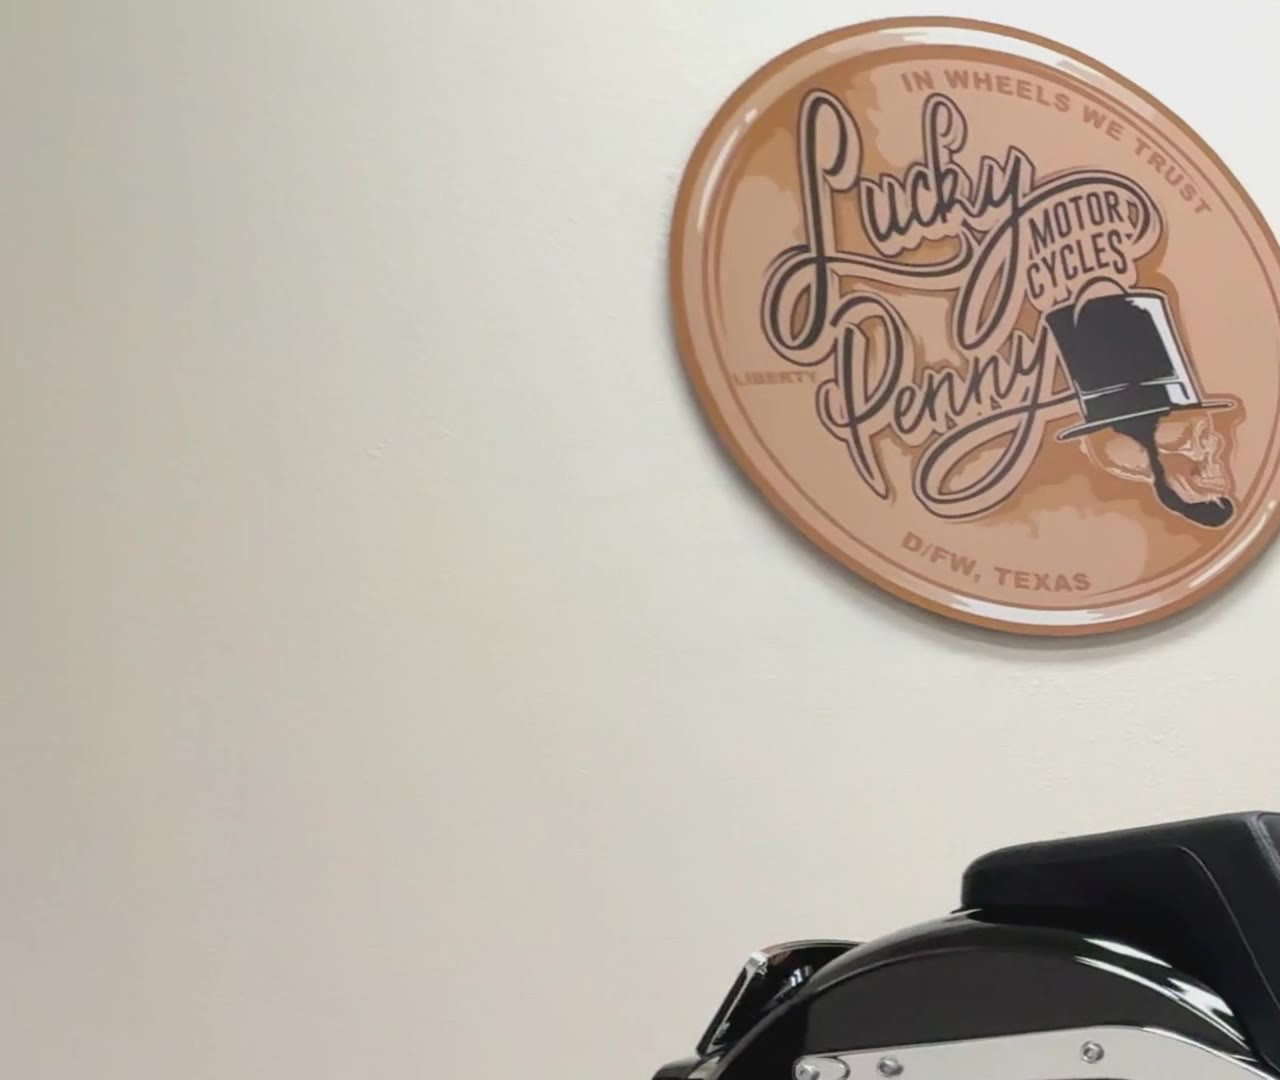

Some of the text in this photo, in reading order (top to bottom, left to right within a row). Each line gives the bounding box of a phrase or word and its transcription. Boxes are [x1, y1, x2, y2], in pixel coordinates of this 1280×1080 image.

[901, 69, 1213, 215] IN WHEELS WE TRUST
[768, 94, 1152, 351] Lucky
[1028, 190, 1125, 255] MOTOR
[1026, 229, 1128, 299] CYCLES
[732, 370, 816, 386] LIBERTY
[821, 297, 1076, 500] Penny
[901, 531, 1092, 592] D/FW, TEXAS
